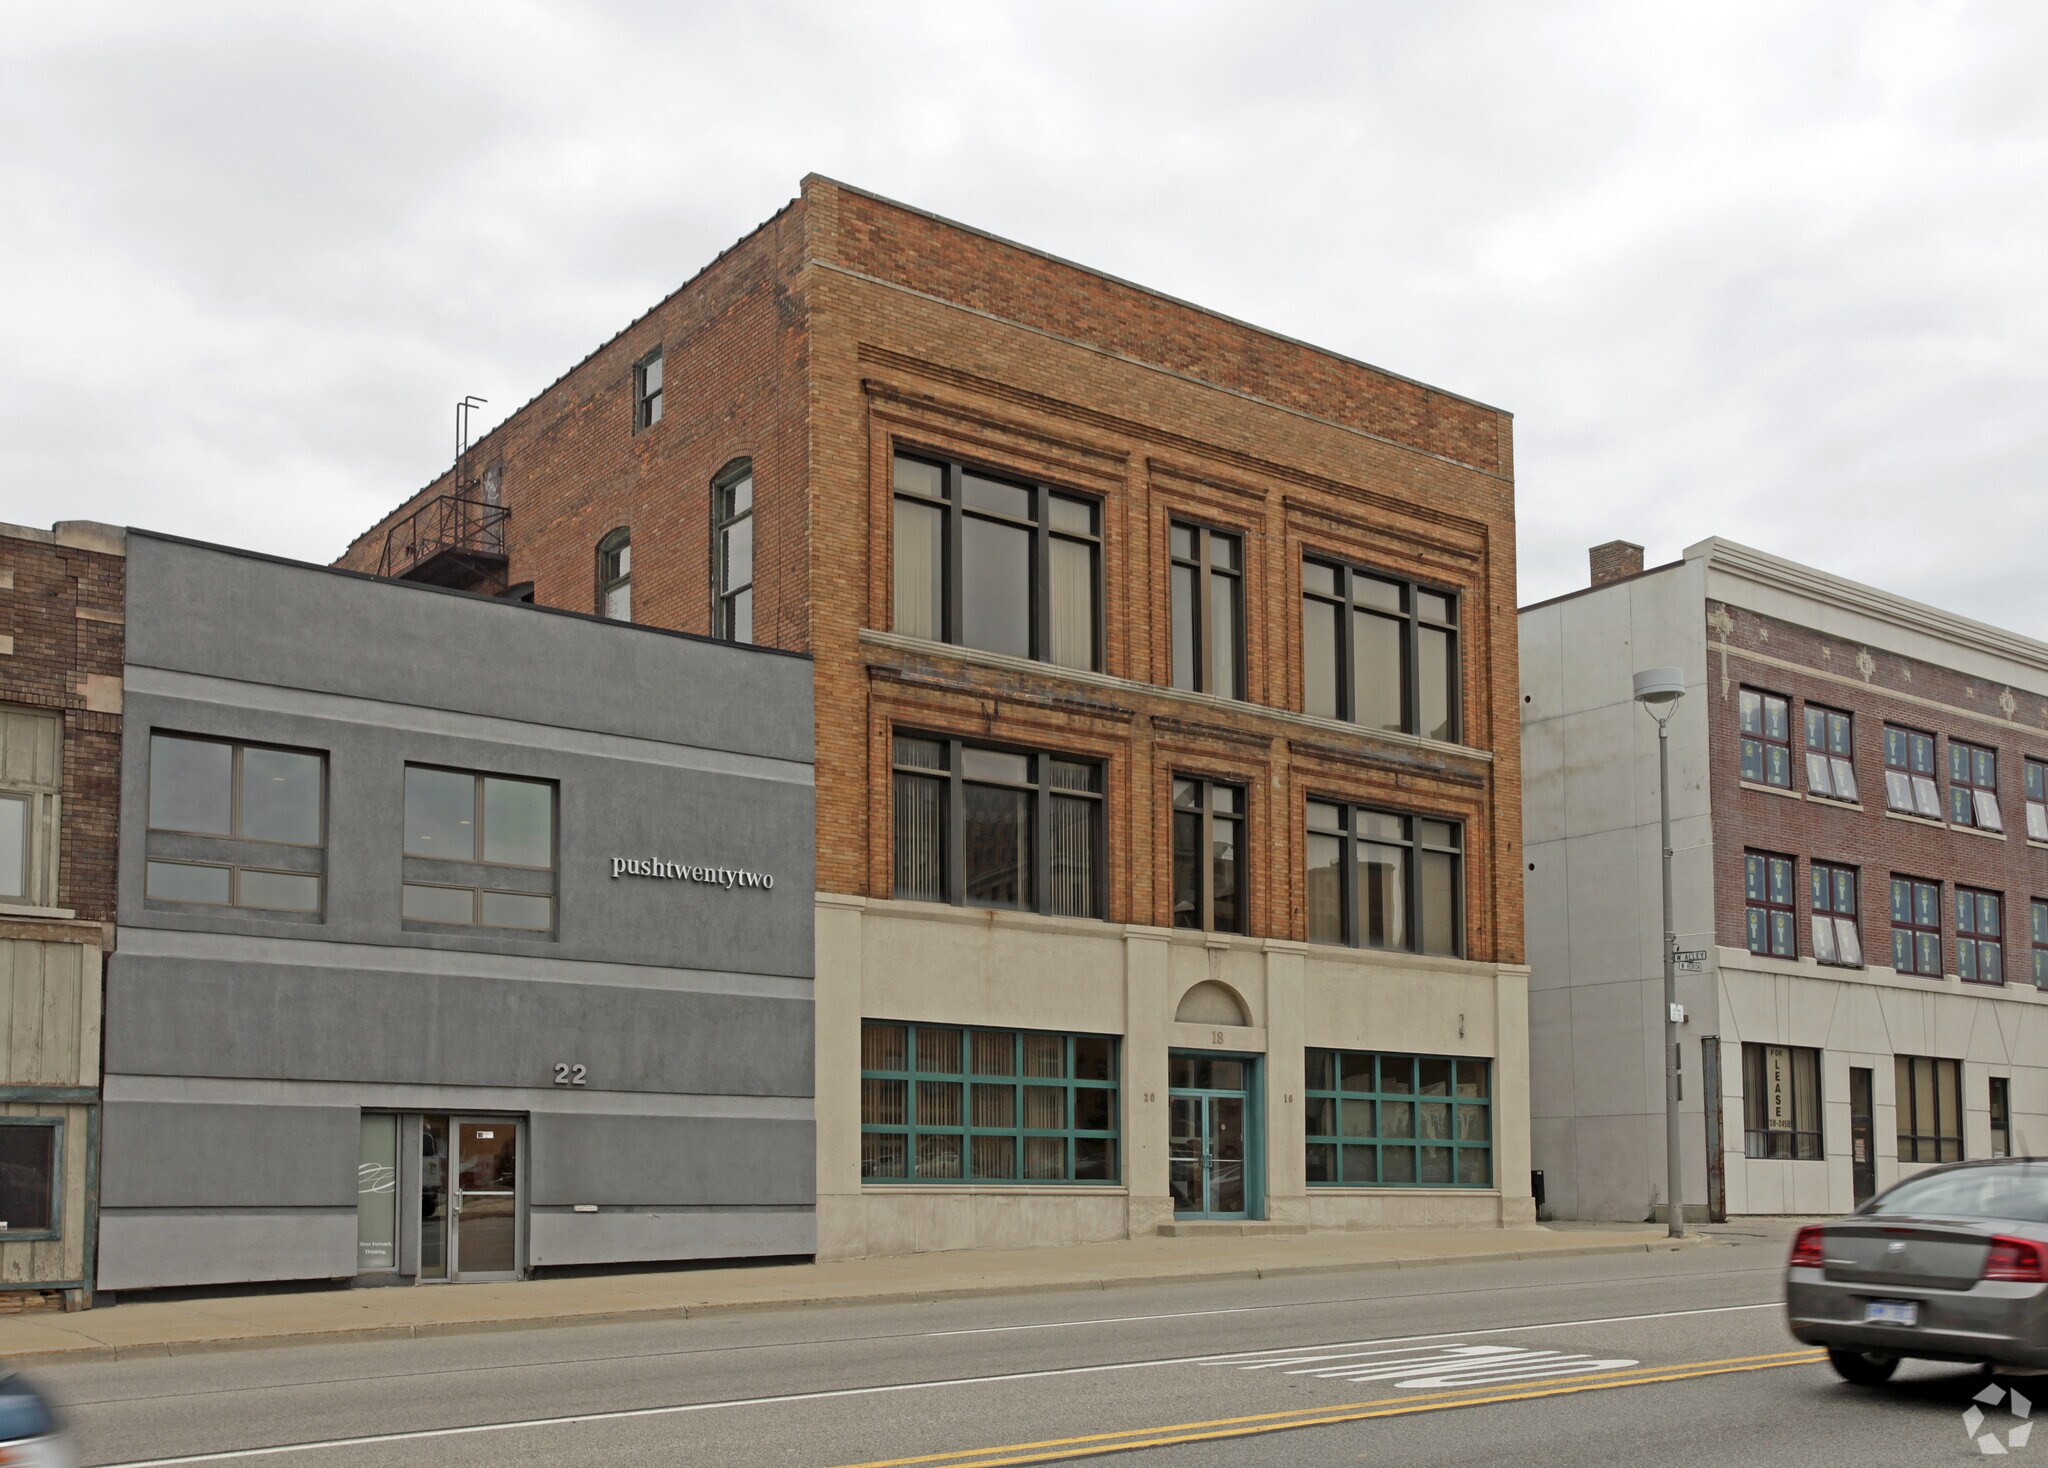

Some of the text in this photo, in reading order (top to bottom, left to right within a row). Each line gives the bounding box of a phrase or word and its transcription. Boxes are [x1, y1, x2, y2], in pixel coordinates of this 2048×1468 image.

[611, 856, 775, 890] pushtwentytwo
[1684, 952, 1704, 961] ALLEY
[1211, 1031, 1224, 1045] 18
[1770, 1049, 1783, 1057] FOR
[554, 1062, 587, 1085] 22
[1774, 1059, 1782, 1117] LEASE
[1143, 1092, 1155, 1103] 20
[1283, 1094, 1294, 1104] 16
